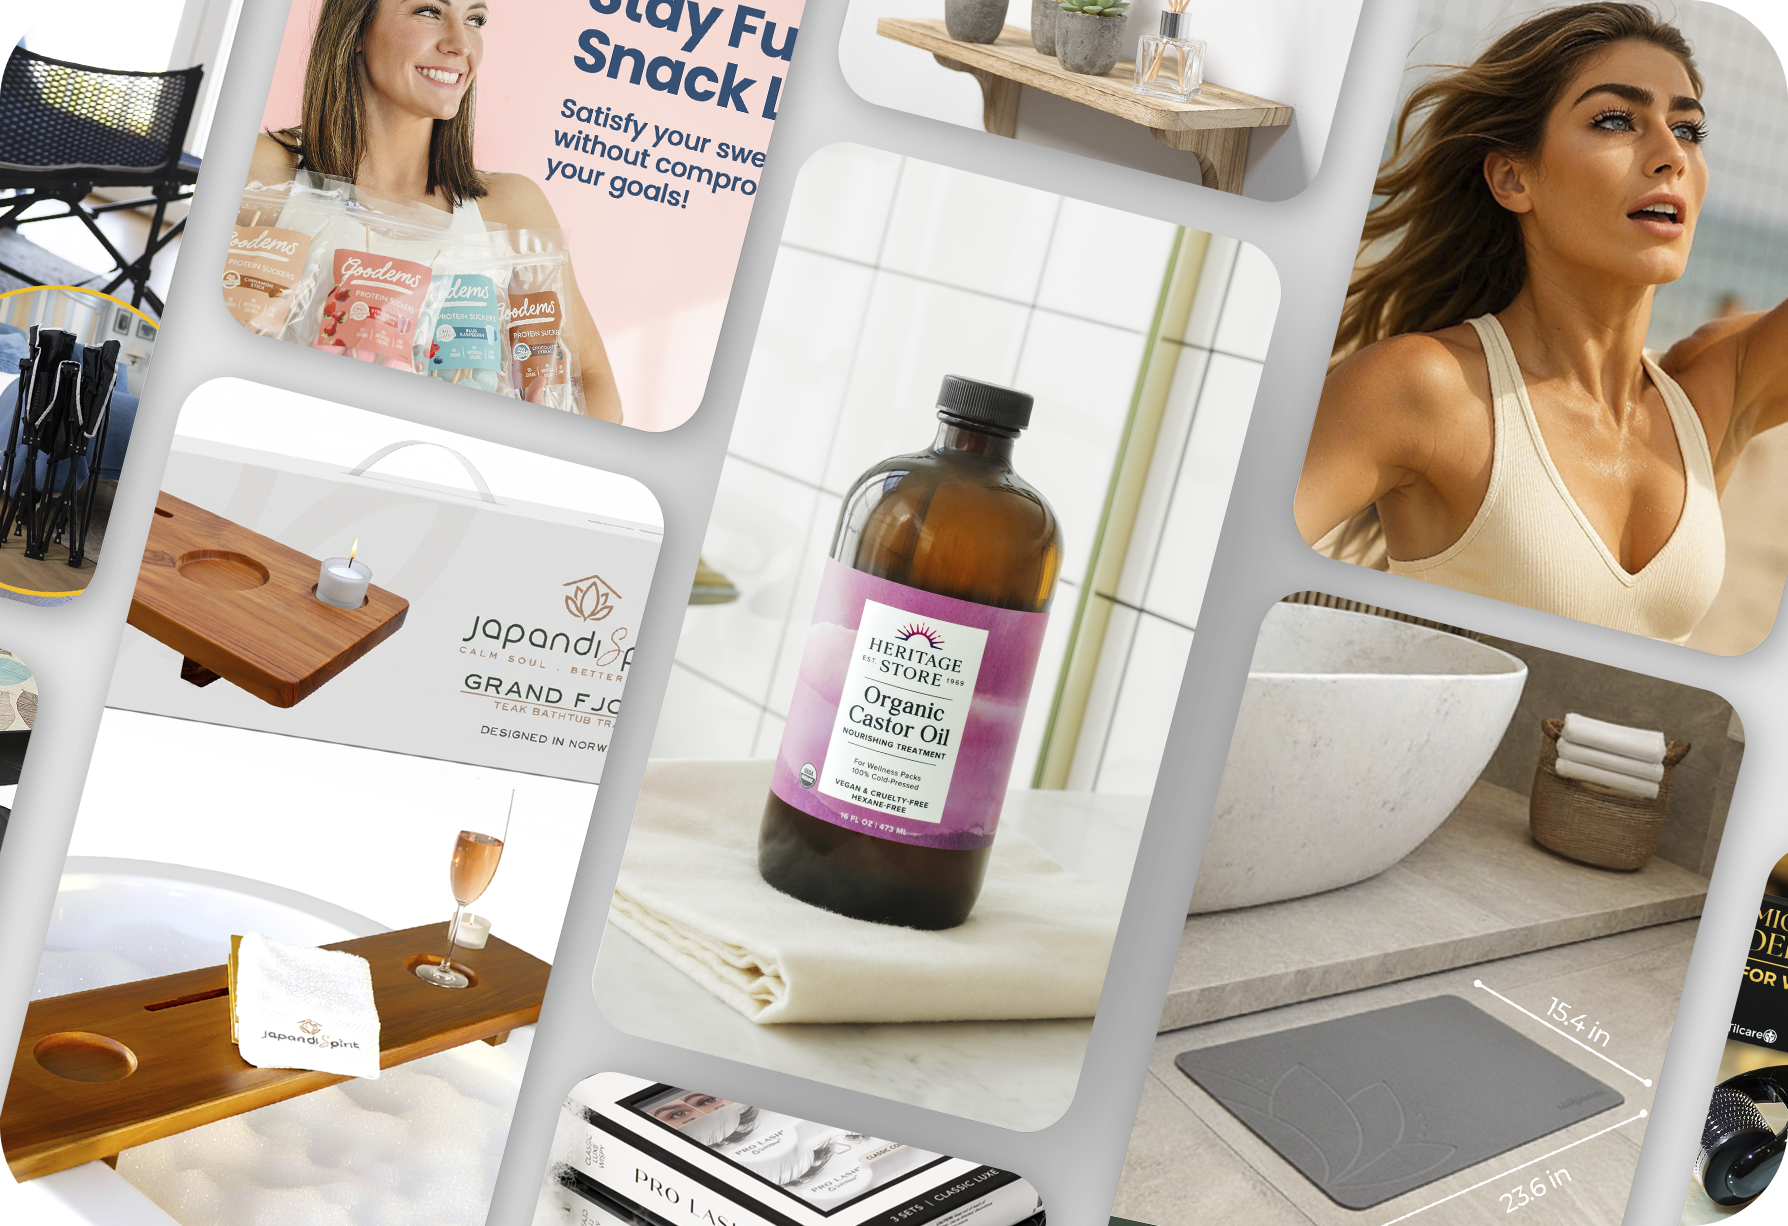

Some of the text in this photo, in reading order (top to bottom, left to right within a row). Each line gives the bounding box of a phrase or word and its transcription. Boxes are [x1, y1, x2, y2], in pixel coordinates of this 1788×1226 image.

[727, 4, 799, 62] Fu
[573, 28, 757, 115] Snack
[560, 98, 766, 168] Satisfy your swe
[554, 129, 757, 196] without compro
[545, 157, 690, 209] your goals!
[228, 259, 295, 281] PROTEIN SUCKERS
[339, 257, 422, 288] Goodems
[356, 290, 415, 314] PROTEIN SUCKERS
[469, 313, 497, 323] SUCKERS
[513, 330, 540, 338] PROTEIN
[459, 646, 498, 660] CALM
[508, 655, 546, 669] SOUL
[571, 667, 623, 682] BETTER
[869, 637, 962, 673] HERITAGE
[862, 655, 965, 687] EST. STORE 1969
[464, 673, 562, 704] GRAND
[864, 685, 945, 722] Organic
[494, 701, 527, 714] TEAK
[532, 707, 591, 725] BATHTUB
[849, 704, 951, 746] Castor Oil
[480, 725, 607, 753] DESIGNED IN NORW
[842, 727, 947, 760] NOURISHING TREATMENT
[852, 767, 920, 791] 100% Cold-Pressed
[854, 758, 922, 782] For Wellness Packs
[835, 778, 861, 792] VEGAN
[871, 790, 929, 809] CRUELTY-FREE
[852, 794, 907, 814] HEXANE-FREE
[840, 812, 849, 820] 16
[850, 815, 859, 824] FL
[862, 819, 874, 828] OZ
[879, 823, 894, 833] 473
[896, 827, 907, 836] ML
[735, 1130, 783, 1155] PRO LASH
[635, 1168, 735, 1226] PRO LAS
[811, 1181, 833, 1192] PRO
[890, 1215, 900, 1223] 3
[898, 1204, 924, 1219] SETS
[934, 1180, 975, 1202] CLASSIC
[973, 1168, 999, 1184] LUXE
